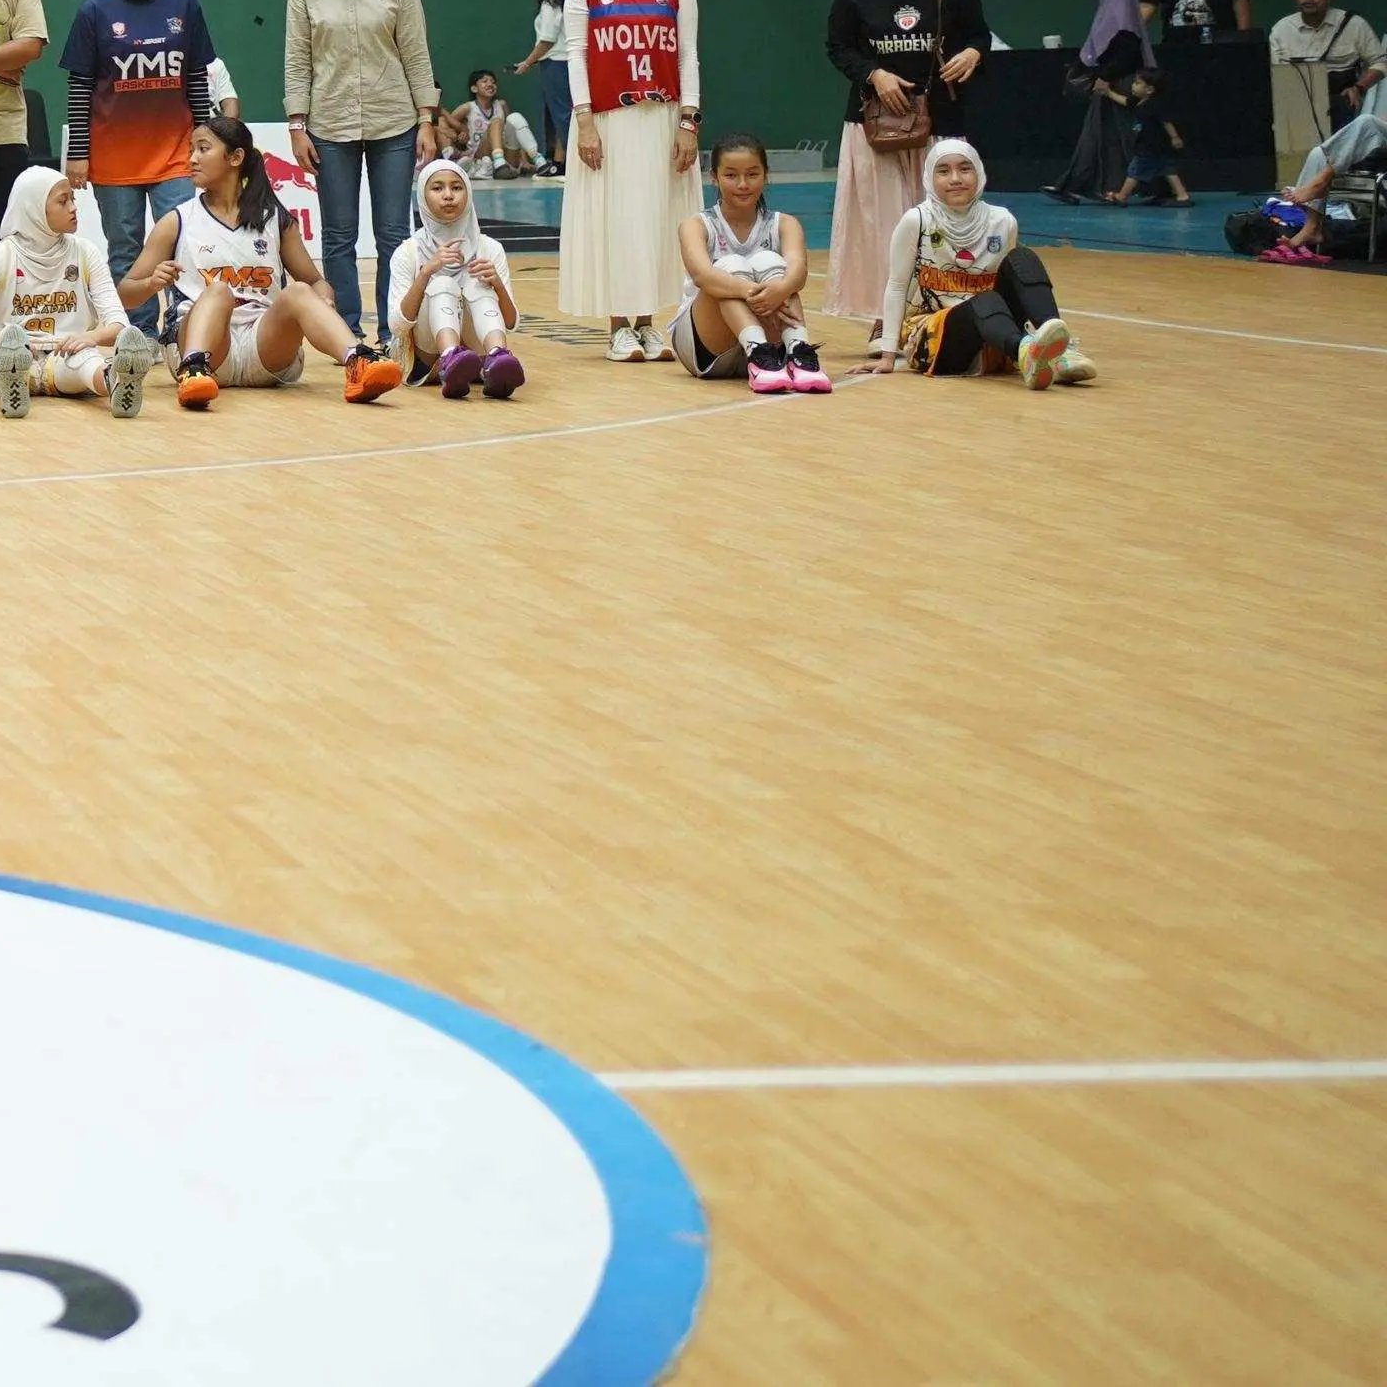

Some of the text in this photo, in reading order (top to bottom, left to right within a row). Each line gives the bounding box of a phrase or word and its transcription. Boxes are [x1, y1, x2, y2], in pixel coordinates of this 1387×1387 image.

[593, 23, 677, 53] WOLVES
[111, 50, 185, 80] YMS
[627, 54, 653, 82] 14
[197, 265, 275, 289] YMS
[12, 290, 78, 308] GARUDA
